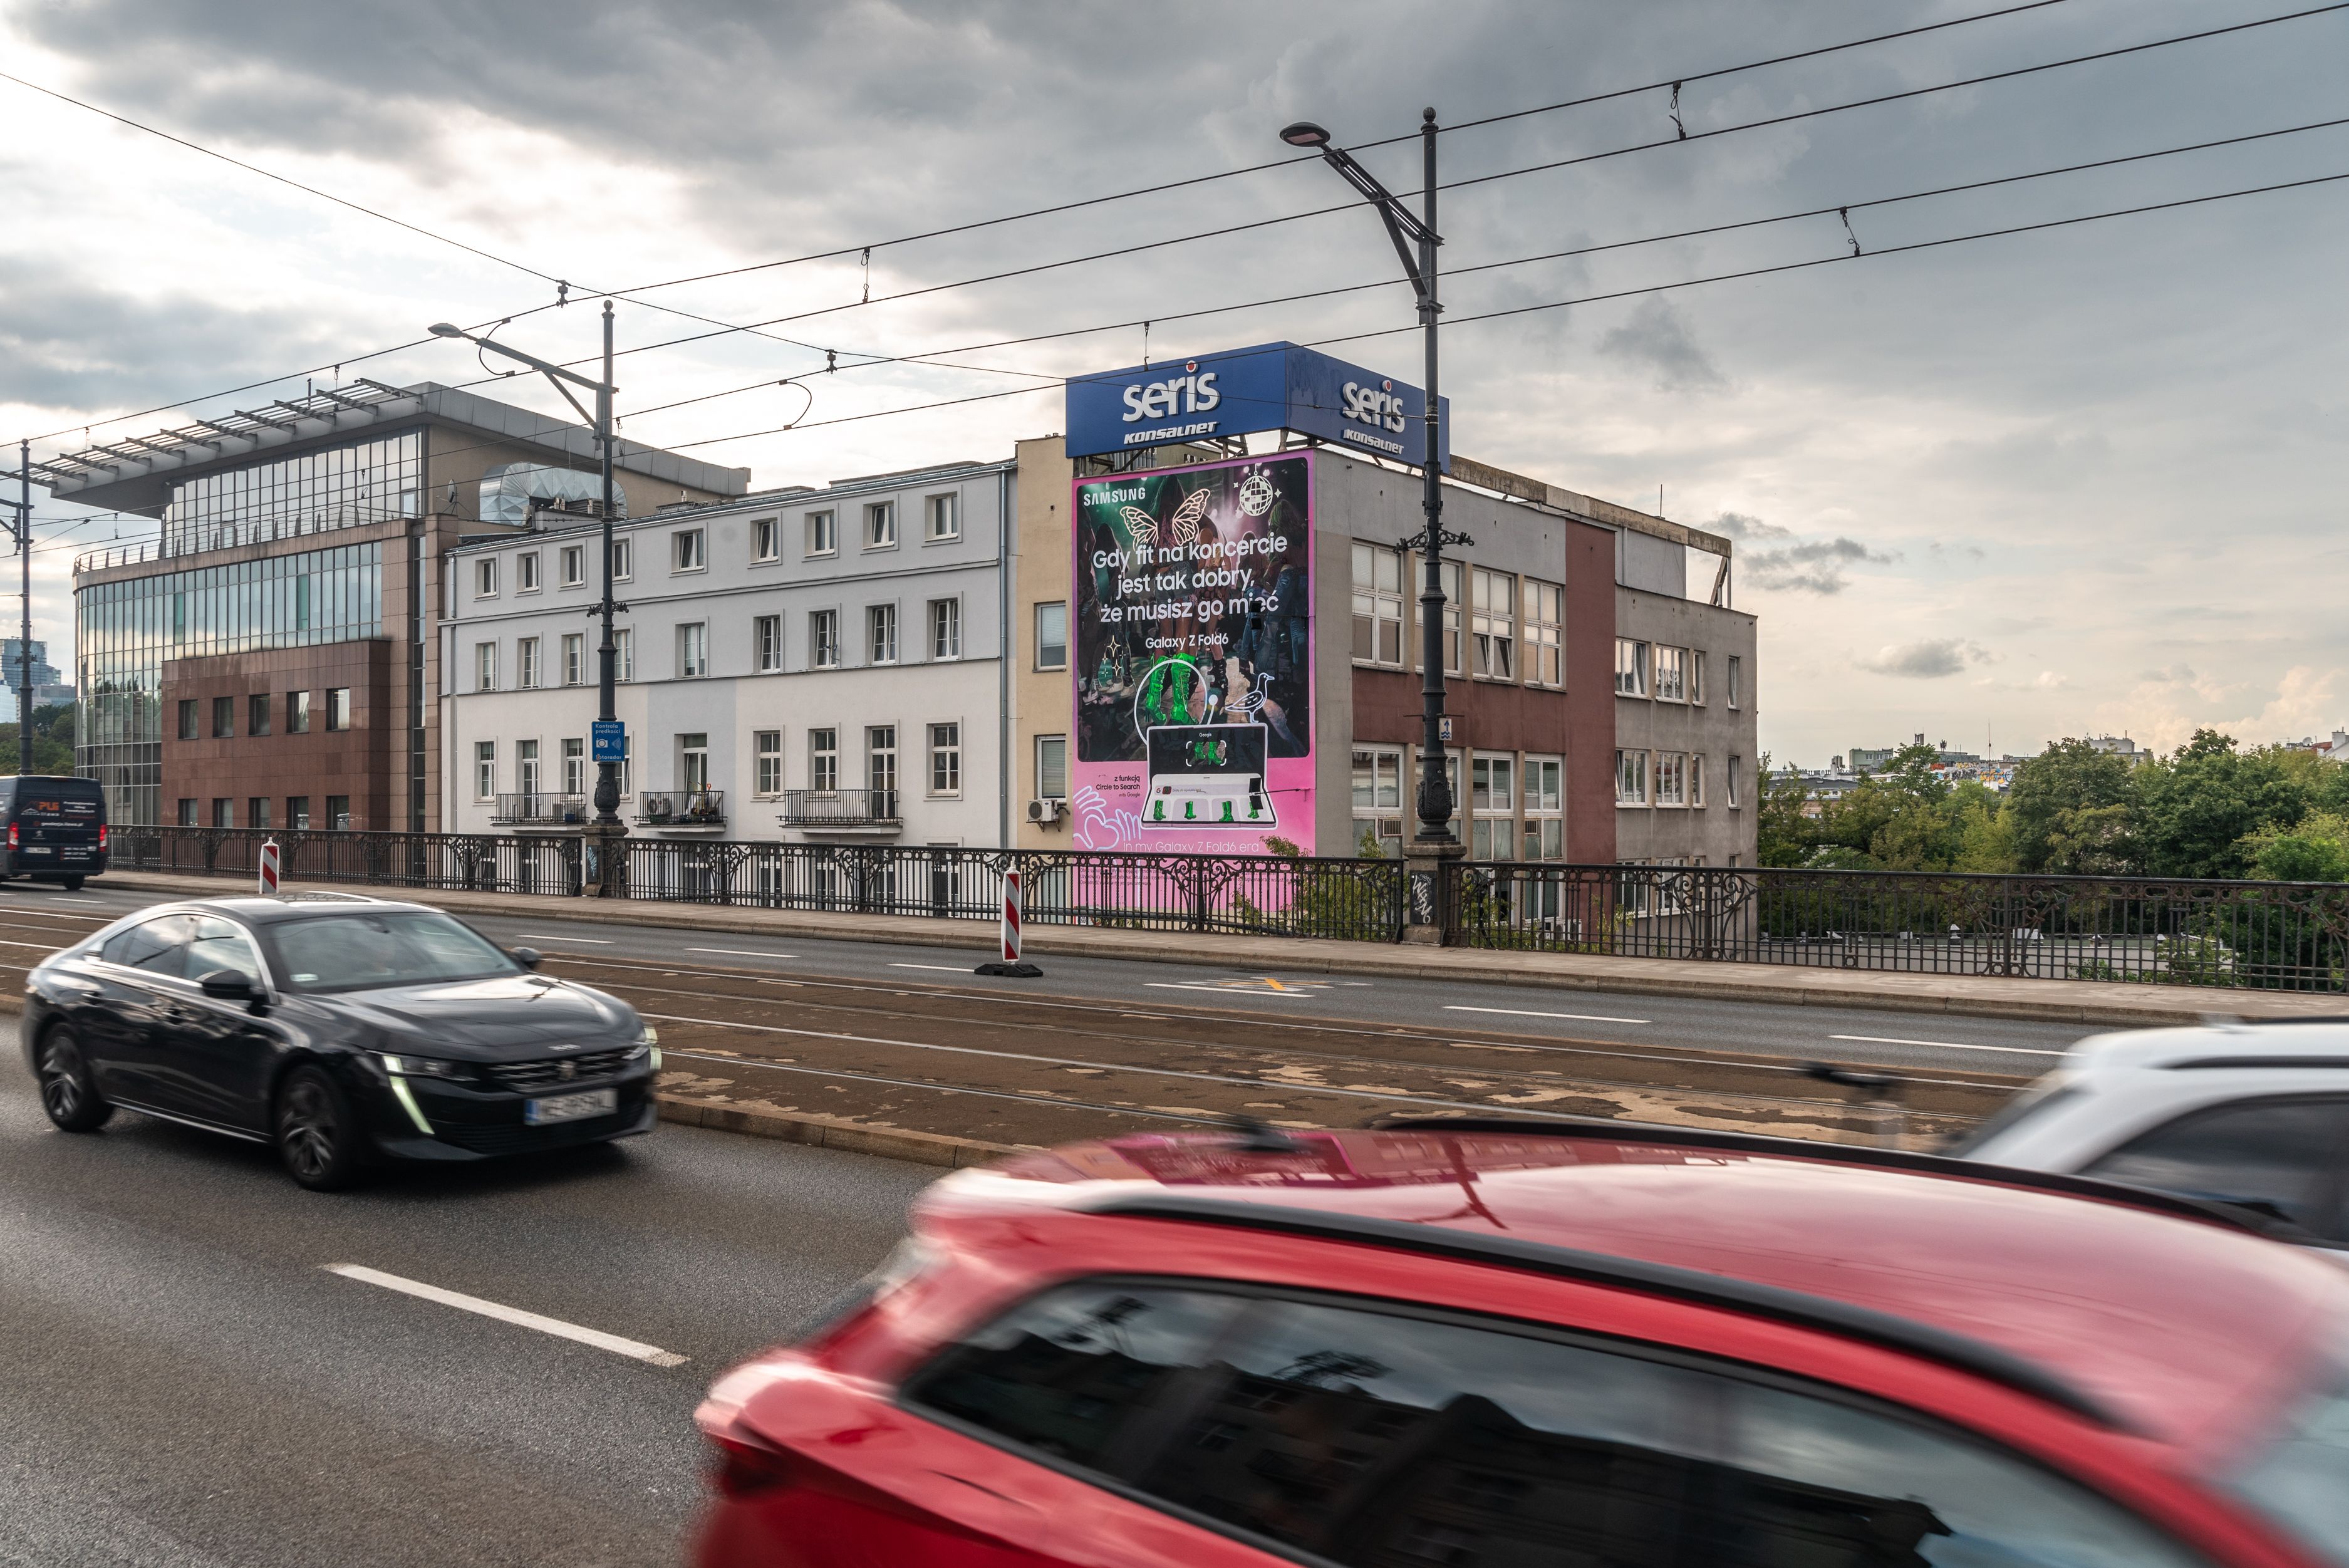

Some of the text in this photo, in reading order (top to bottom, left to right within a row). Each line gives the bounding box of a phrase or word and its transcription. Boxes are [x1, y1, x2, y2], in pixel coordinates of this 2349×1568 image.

[1123, 360, 1220, 422] seris
[1342, 380, 1405, 433] seris
[1084, 487, 1146, 507] SAMSUNG
[1093, 532, 1288, 574] Gdy fit na koncercie
[1116, 567, 1255, 600] jest tak dobry,
[1101, 603, 1123, 623] że
[1128, 598, 1193, 621] musisz
[1198, 598, 1224, 623] go
[1145, 633, 1229, 650] Galaxy Z Fold6
[1119, 774, 1140, 782] funkcją
[1124, 841, 1259, 853] In my Galaxy Z Fold6 era
